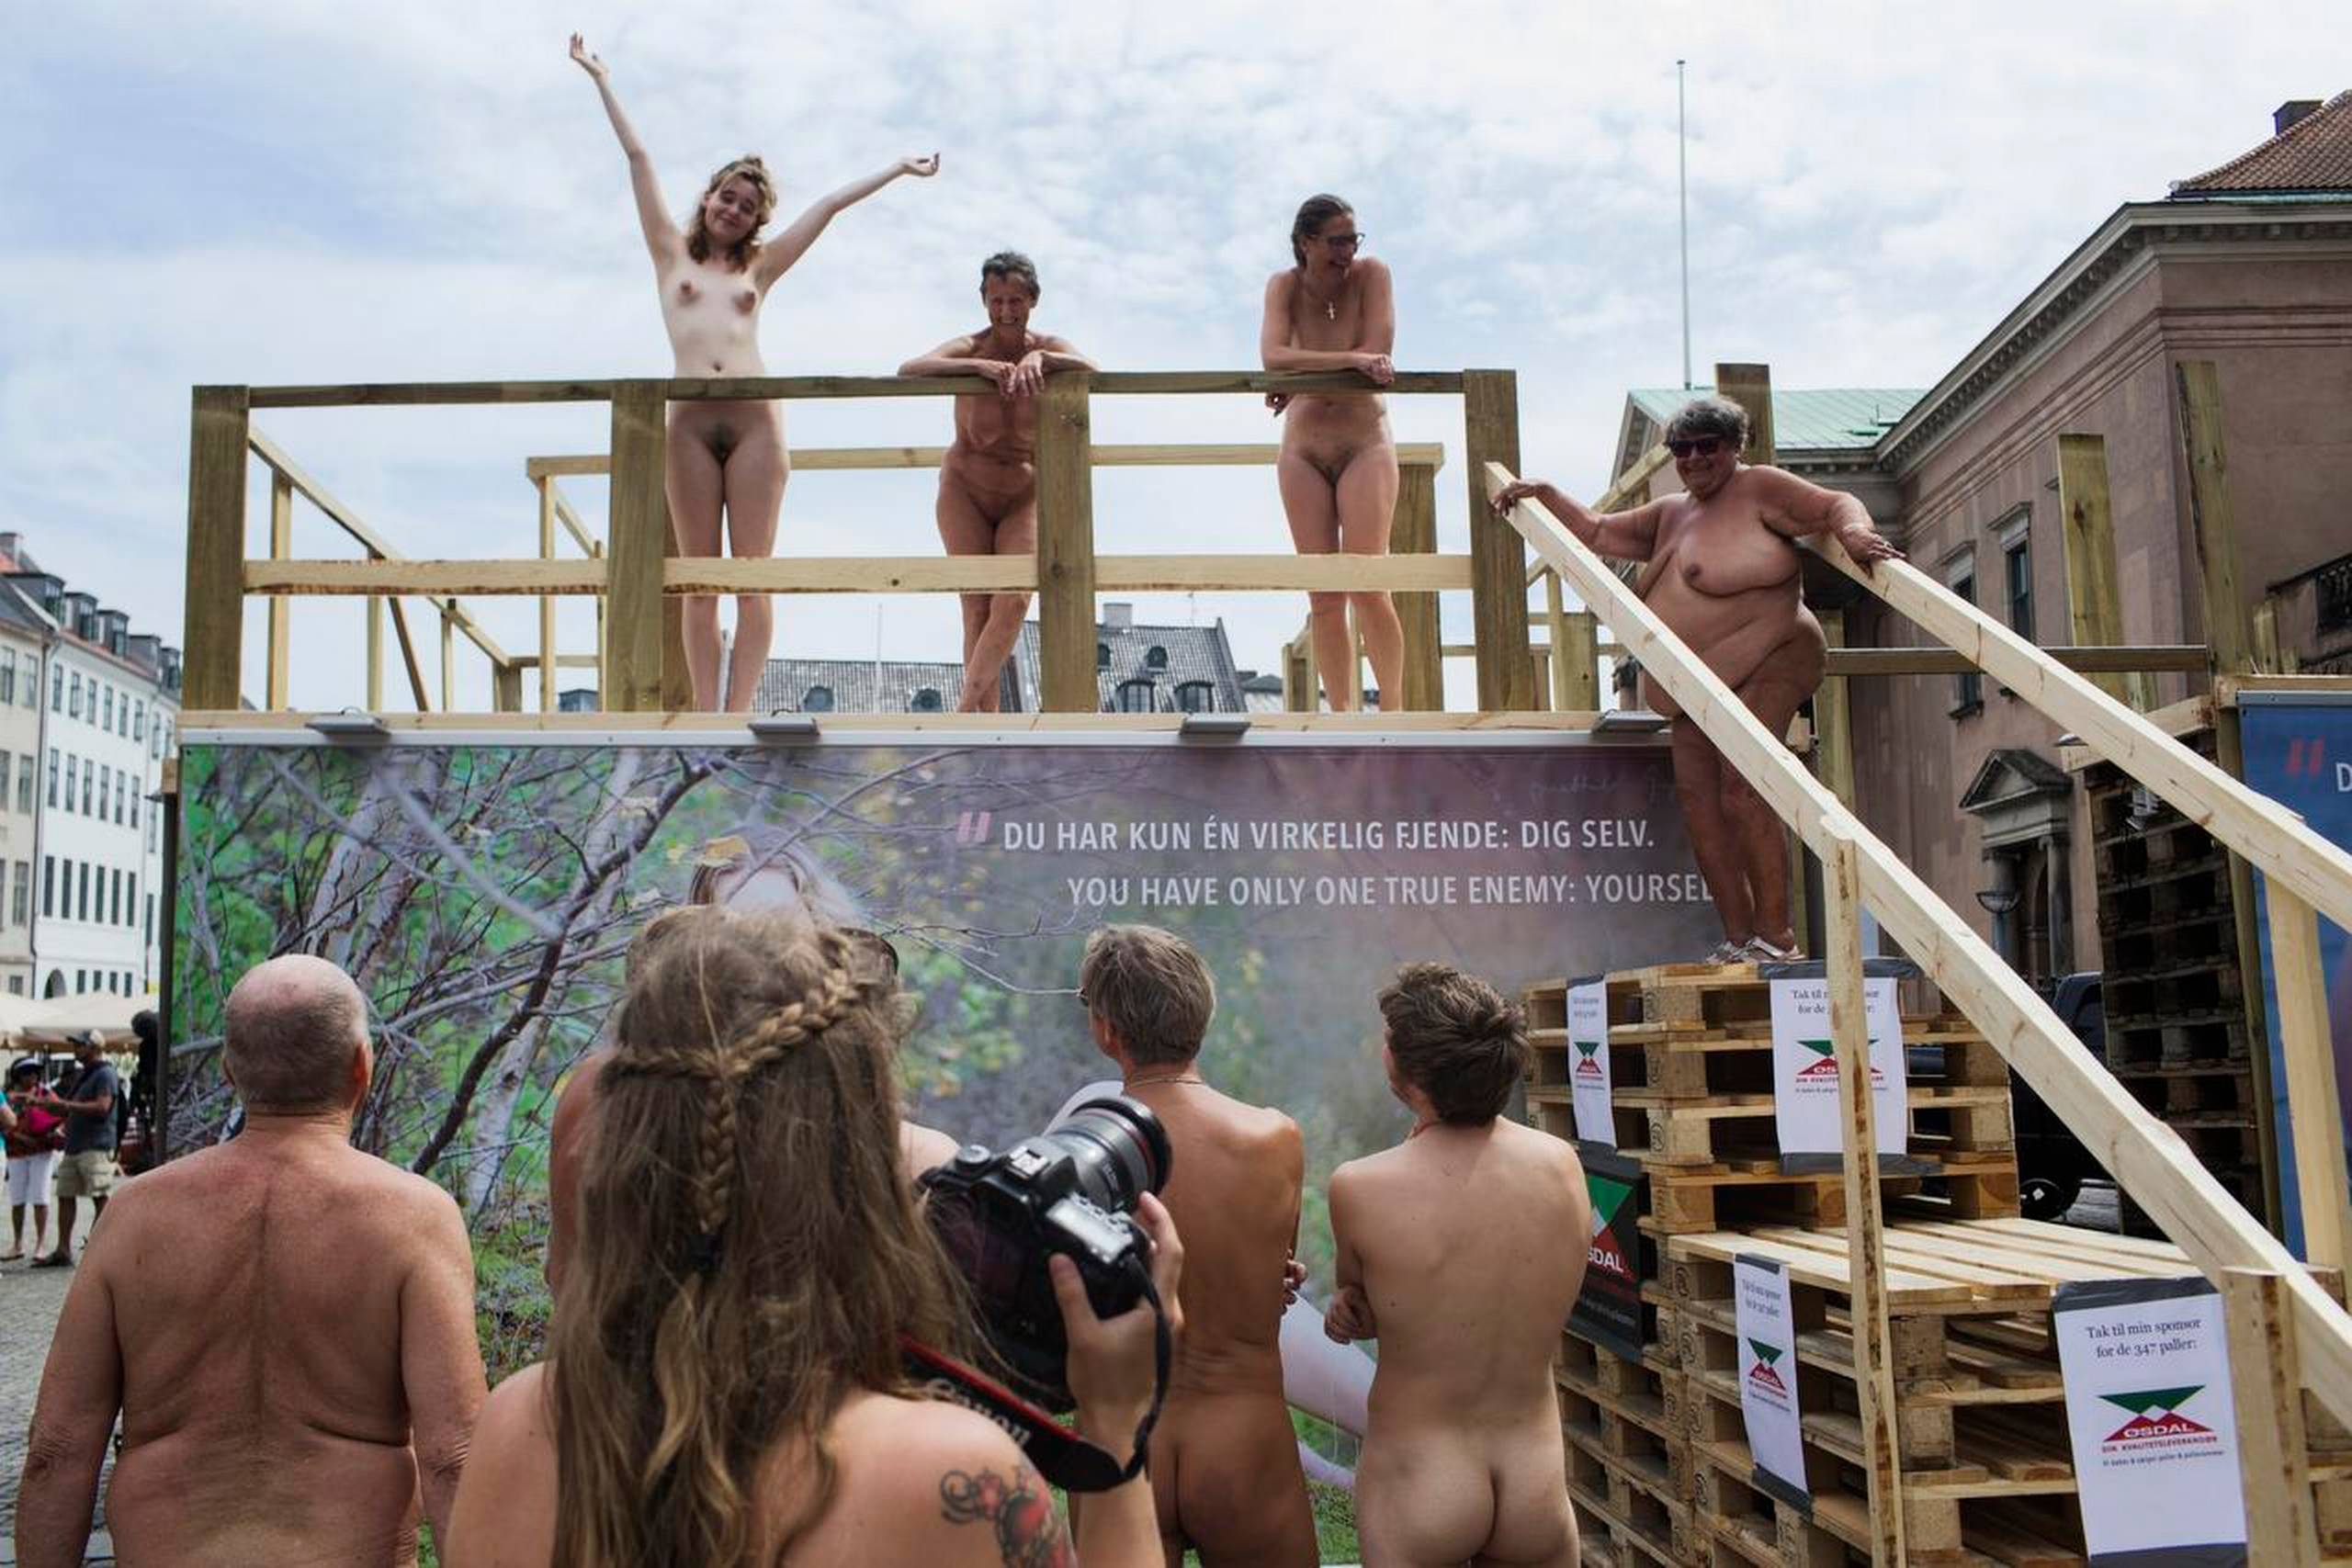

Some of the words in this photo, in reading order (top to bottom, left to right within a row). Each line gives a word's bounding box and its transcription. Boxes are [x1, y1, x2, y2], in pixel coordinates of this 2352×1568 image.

[1004, 822, 1045, 851] DU
[1057, 822, 1118, 851] HAR
[1129, 822, 1191, 851] KUN
[1204, 815, 1239, 850] ÉN
[1250, 821, 1384, 850] VIRKELIG
[1396, 821, 1509, 850] FJENDE:
[1521, 820, 1571, 849] DIG
[1581, 819, 1655, 848] SELV.
[1068, 877, 1129, 907] YOU
[1141, 877, 1218, 907] HAVE
[1229, 876, 1306, 906] ONLY
[1316, 876, 1375, 906] ONE
[1385, 876, 1457, 905] TRUE
[1470, 875, 1575, 904] ENEMY:
[1586, 874, 1714, 903] YOURSEL
[1588, 1247, 1623, 1273] SDAL
[2086, 1324, 2110, 1339] Tak
[2112, 1323, 2125, 1337] til
[2128, 1320, 2152, 1335] min
[2154, 1318, 2201, 1335] sponsor
[2097, 1344, 2113, 1359] for
[2116, 1343, 2131, 1356] de
[2123, 1423, 2195, 1438] OSDAL
